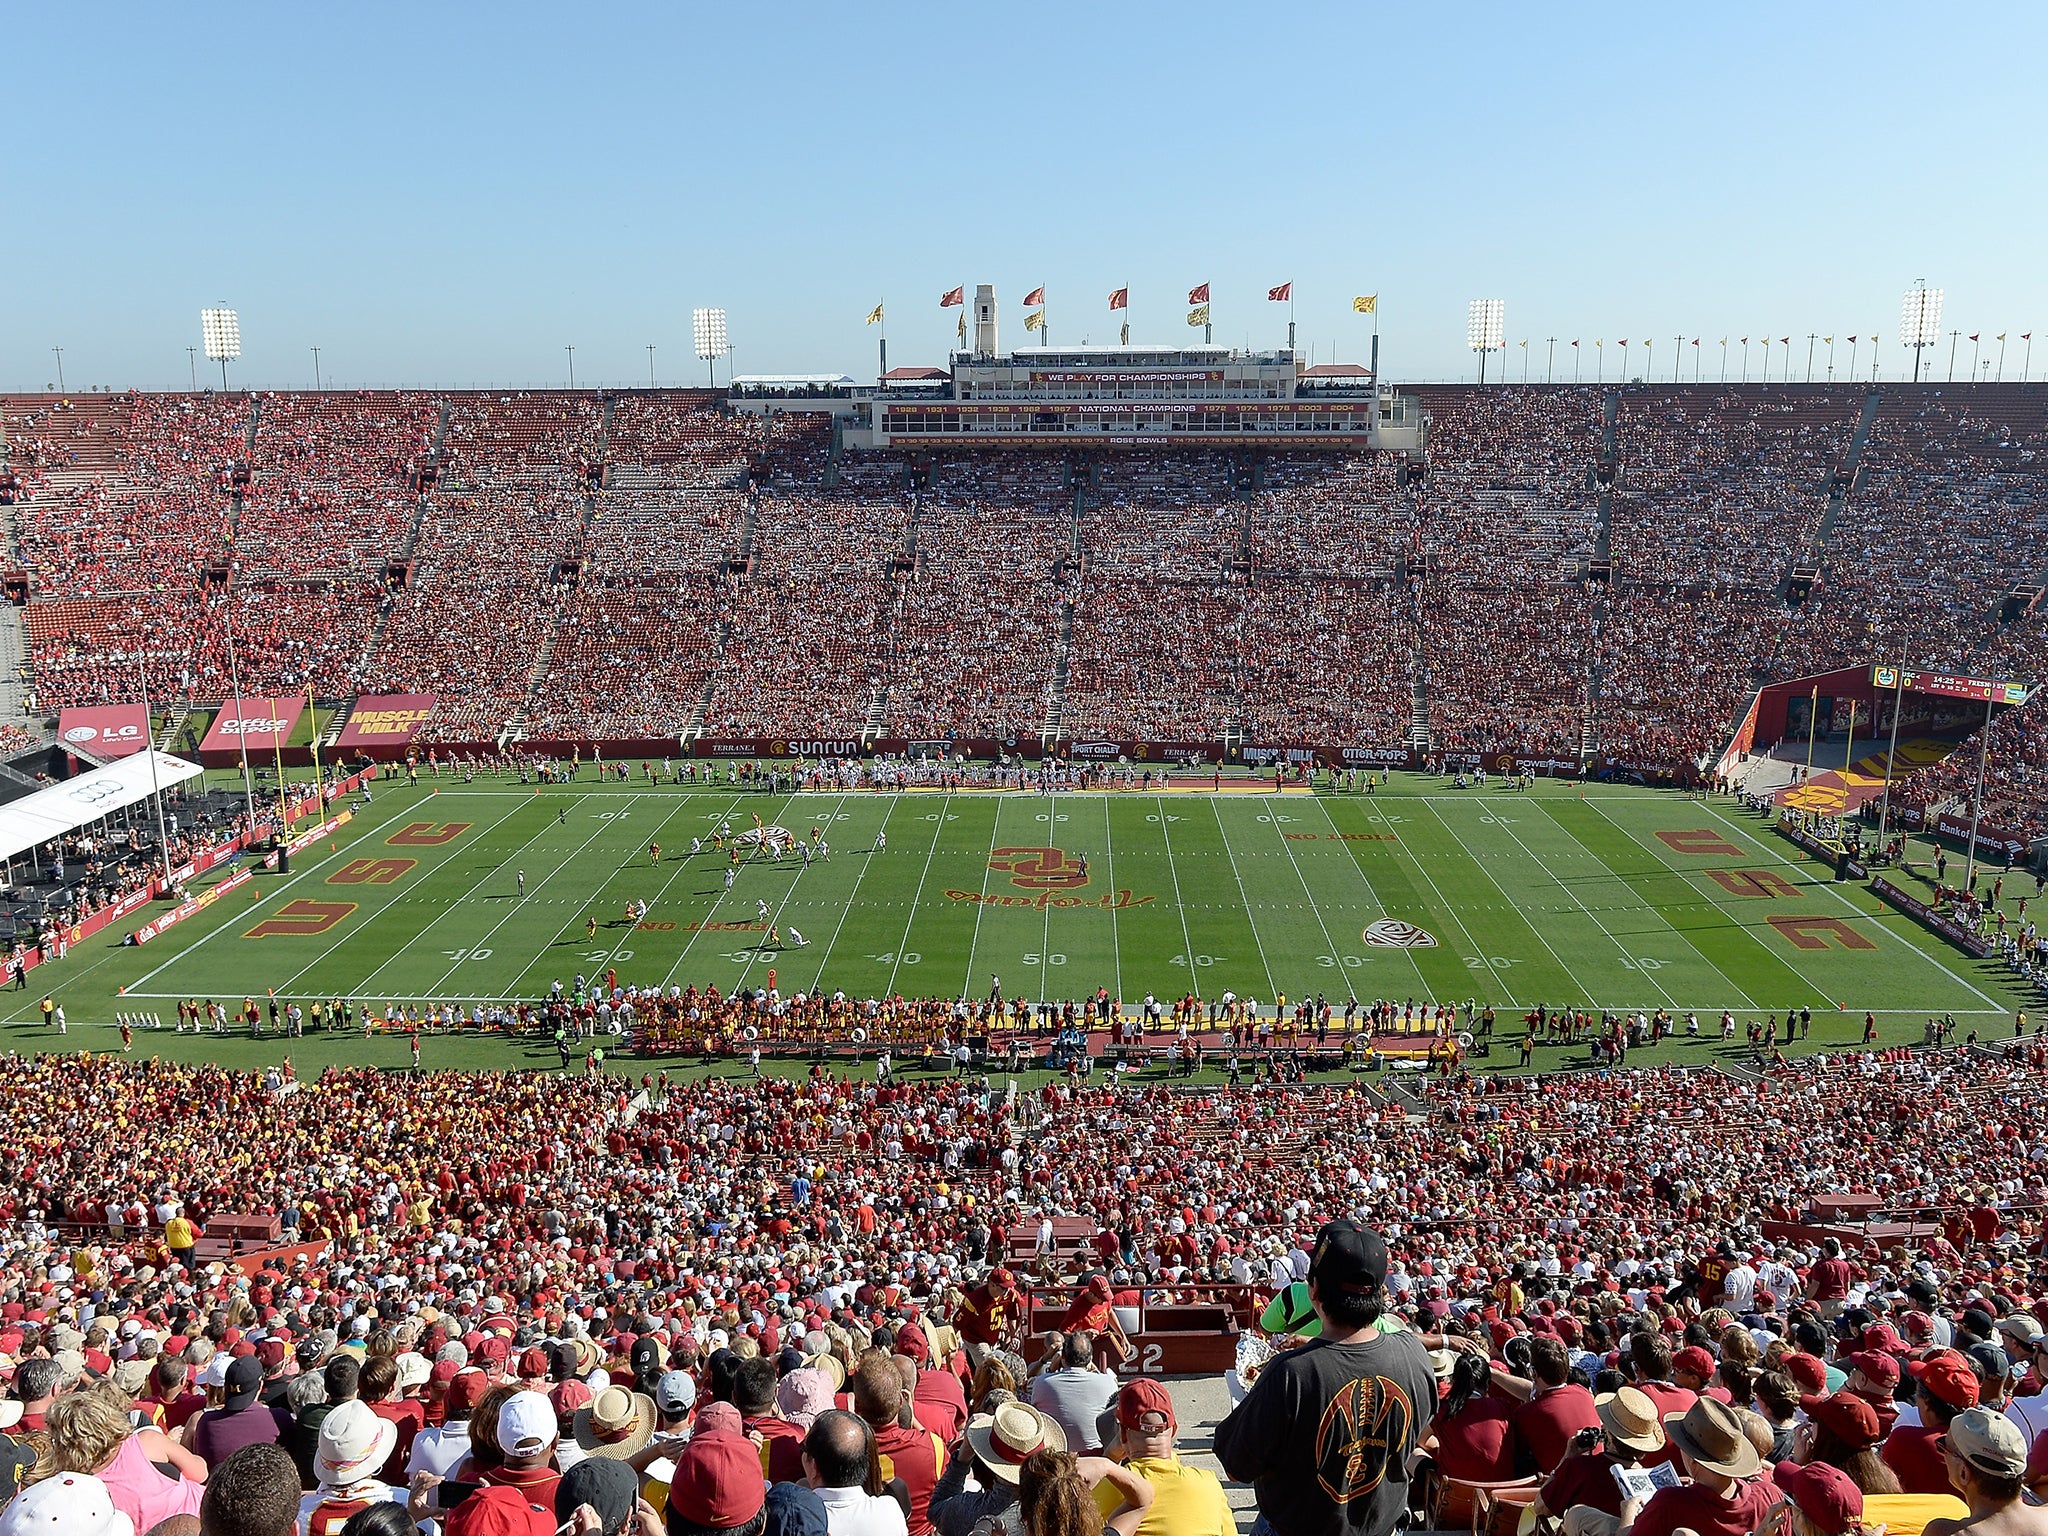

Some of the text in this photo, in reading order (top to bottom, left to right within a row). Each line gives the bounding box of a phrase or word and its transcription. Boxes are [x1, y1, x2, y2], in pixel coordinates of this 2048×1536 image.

[1066, 374, 1092, 382] PLAY
[1119, 372, 1206, 381] CHAMPIONSHIPS
[1904, 678, 1911, 687] 0
[1934, 676, 1955, 685] 14:25
[1984, 688, 1991, 697] 0
[350, 710, 430, 723] MUSCLE
[222, 718, 288, 728] Office
[358, 722, 412, 734] MILK
[103, 726, 138, 738] LG
[218, 726, 286, 734] DEPOT
[788, 741, 857, 754] sunrun
[1287, 748, 1314, 761] MILK
[600, 812, 631, 820] 10
[707, 812, 743, 820] 20
[1146, 814, 1180, 822] 40
[1256, 815, 1292, 823] 30
[1367, 816, 1404, 824] 20
[1479, 816, 1511, 824] 10
[1940, 822, 2003, 850] Bank of merica
[241, 822, 475, 938] USC
[1654, 829, 1880, 951] USC
[945, 890, 1157, 911] Trojans
[634, 922, 770, 932] ON FIGHT
[449, 948, 494, 961] 10
[585, 950, 635, 962] 20
[731, 951, 778, 963] 30
[876, 952, 922, 964] 40
[1022, 954, 1067, 966] 50
[1169, 954, 1214, 966] 40
[1315, 956, 1362, 968] 30
[1462, 956, 1512, 970] 20
[1618, 957, 1662, 970] 10
[1956, 1226, 1964, 1238] 7
[1164, 1240, 1173, 1256] 7
[1904, 1238, 1920, 1248] 21
[1706, 1262, 1722, 1282] 15
[990, 1306, 1004, 1332] 5
[1118, 1344, 1163, 1373] 22
